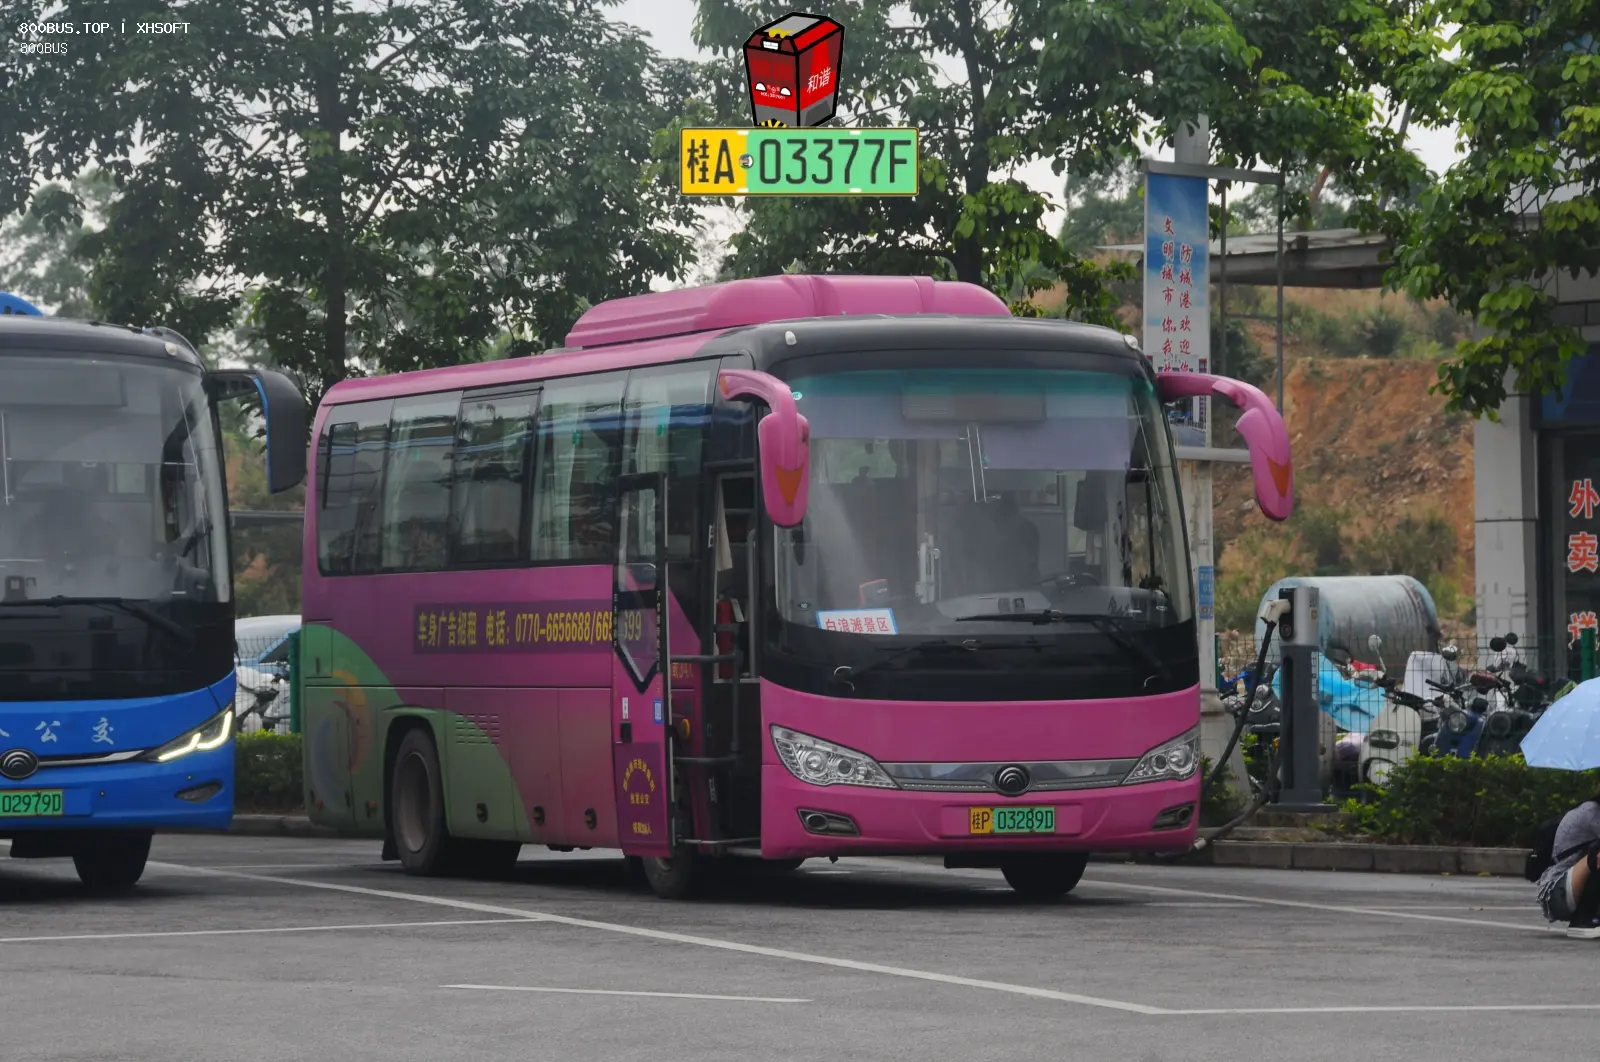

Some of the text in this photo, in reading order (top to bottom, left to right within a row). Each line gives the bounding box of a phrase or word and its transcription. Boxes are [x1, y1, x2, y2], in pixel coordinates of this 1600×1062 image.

[417, 610, 477, 647] 车身广告招租
[825, 616, 890, 633] 白浪滩景区
[997, 810, 1054, 830] 03289D
